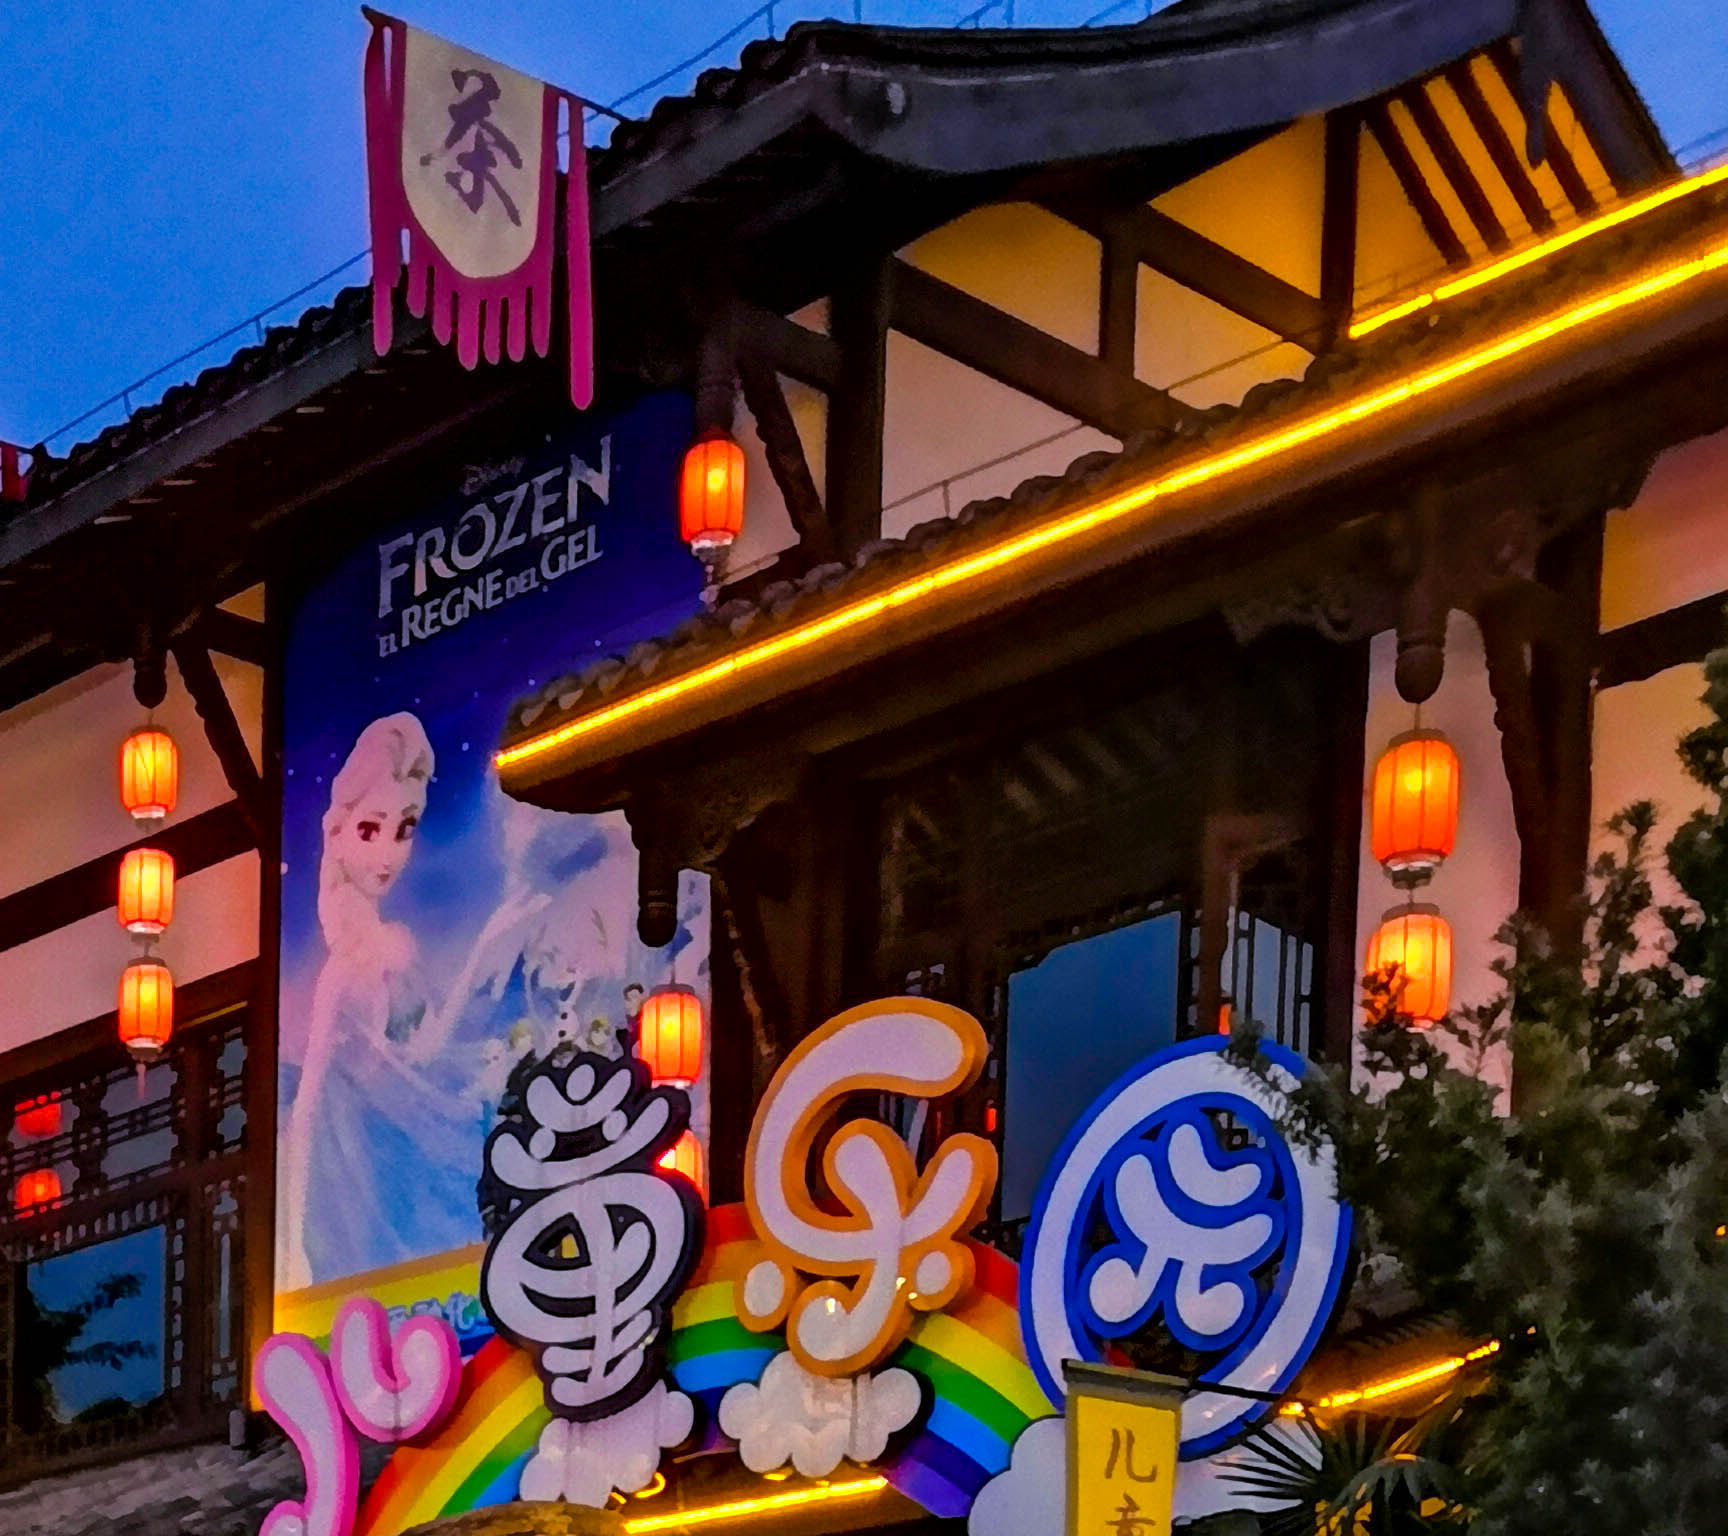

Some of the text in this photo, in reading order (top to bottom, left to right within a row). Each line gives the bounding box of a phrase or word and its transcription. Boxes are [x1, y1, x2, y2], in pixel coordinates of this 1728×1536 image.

[419, 67, 523, 227] 茶
[377, 433, 612, 620] FROZEN
[377, 524, 604, 658] EL REGNE DEL GEL
